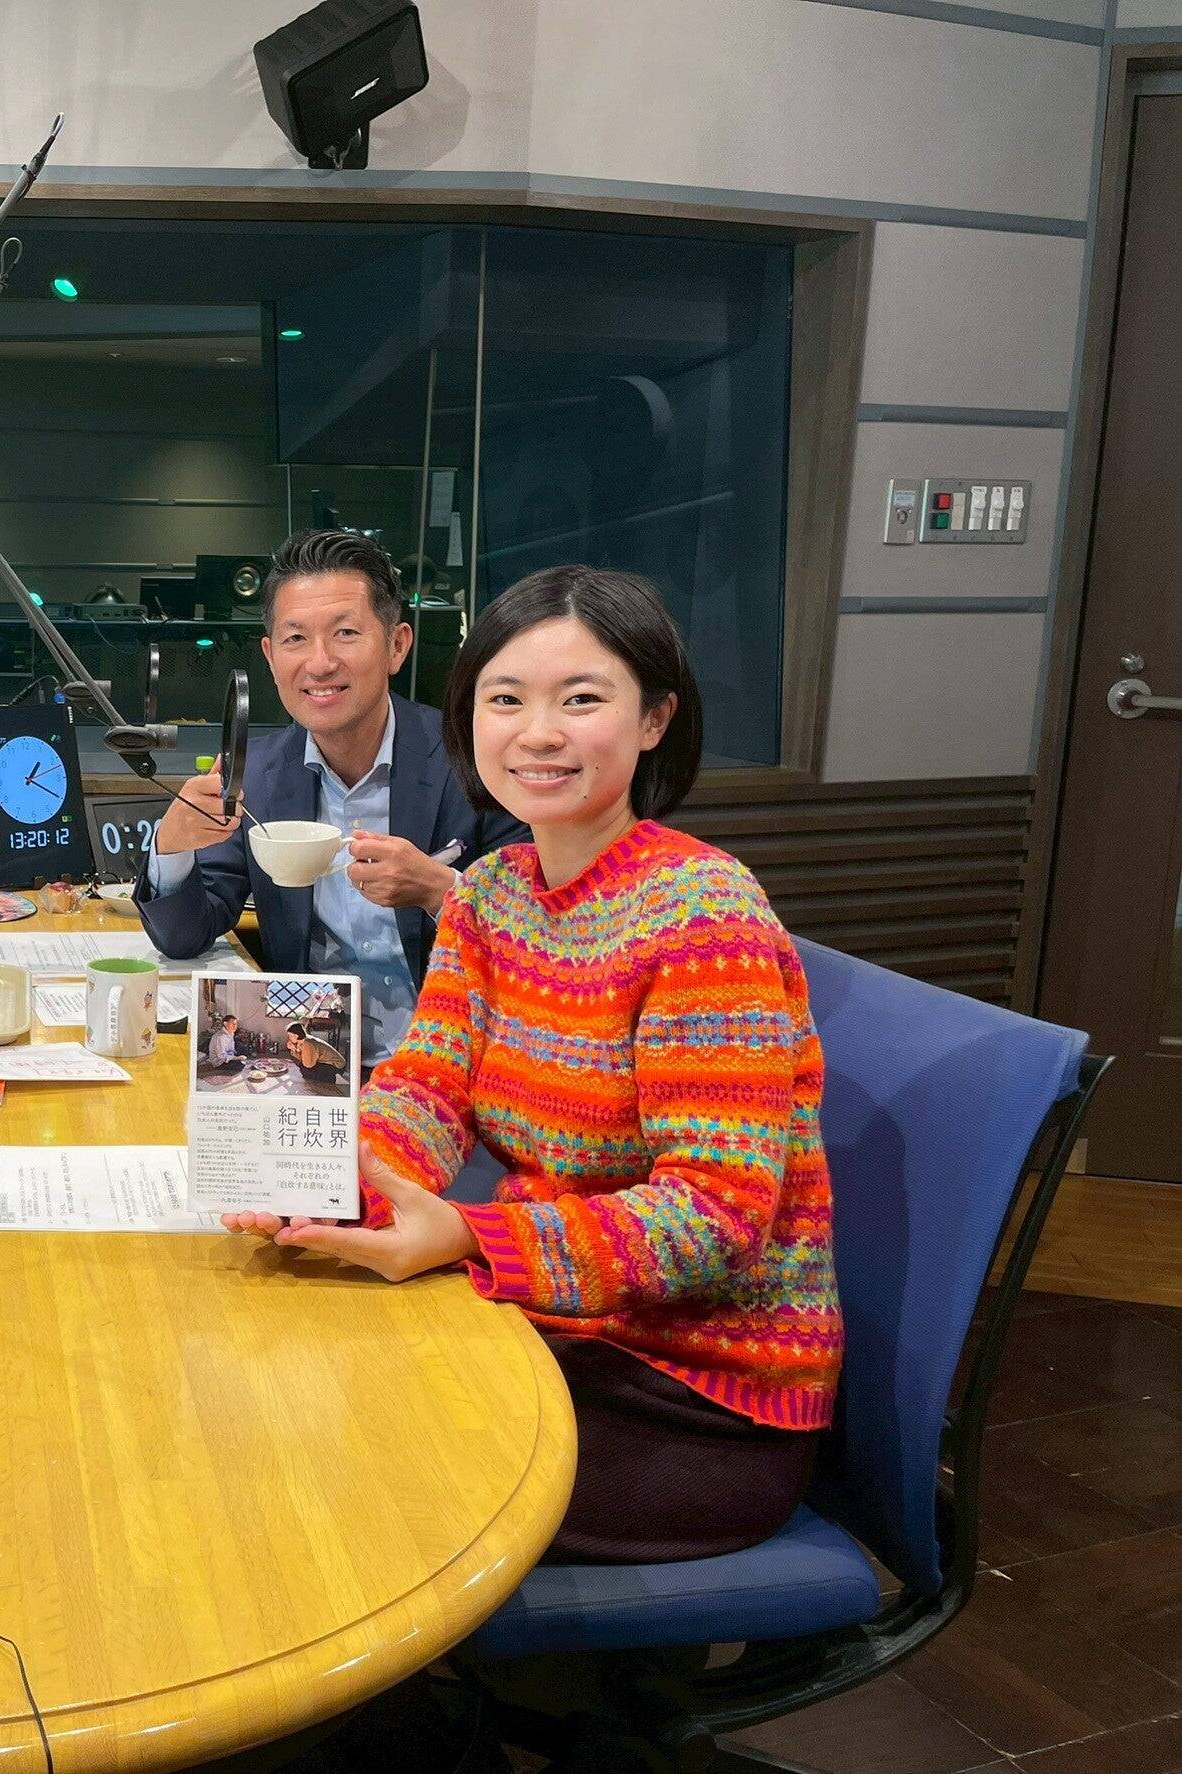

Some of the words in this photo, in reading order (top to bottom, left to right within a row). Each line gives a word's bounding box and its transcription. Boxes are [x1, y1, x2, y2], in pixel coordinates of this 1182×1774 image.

[102, 819, 162, 854] 0:2
[277, 1106, 298, 1147] 紀行
[303, 1106, 323, 1148] 自炊
[328, 1108, 349, 1149] 世界
